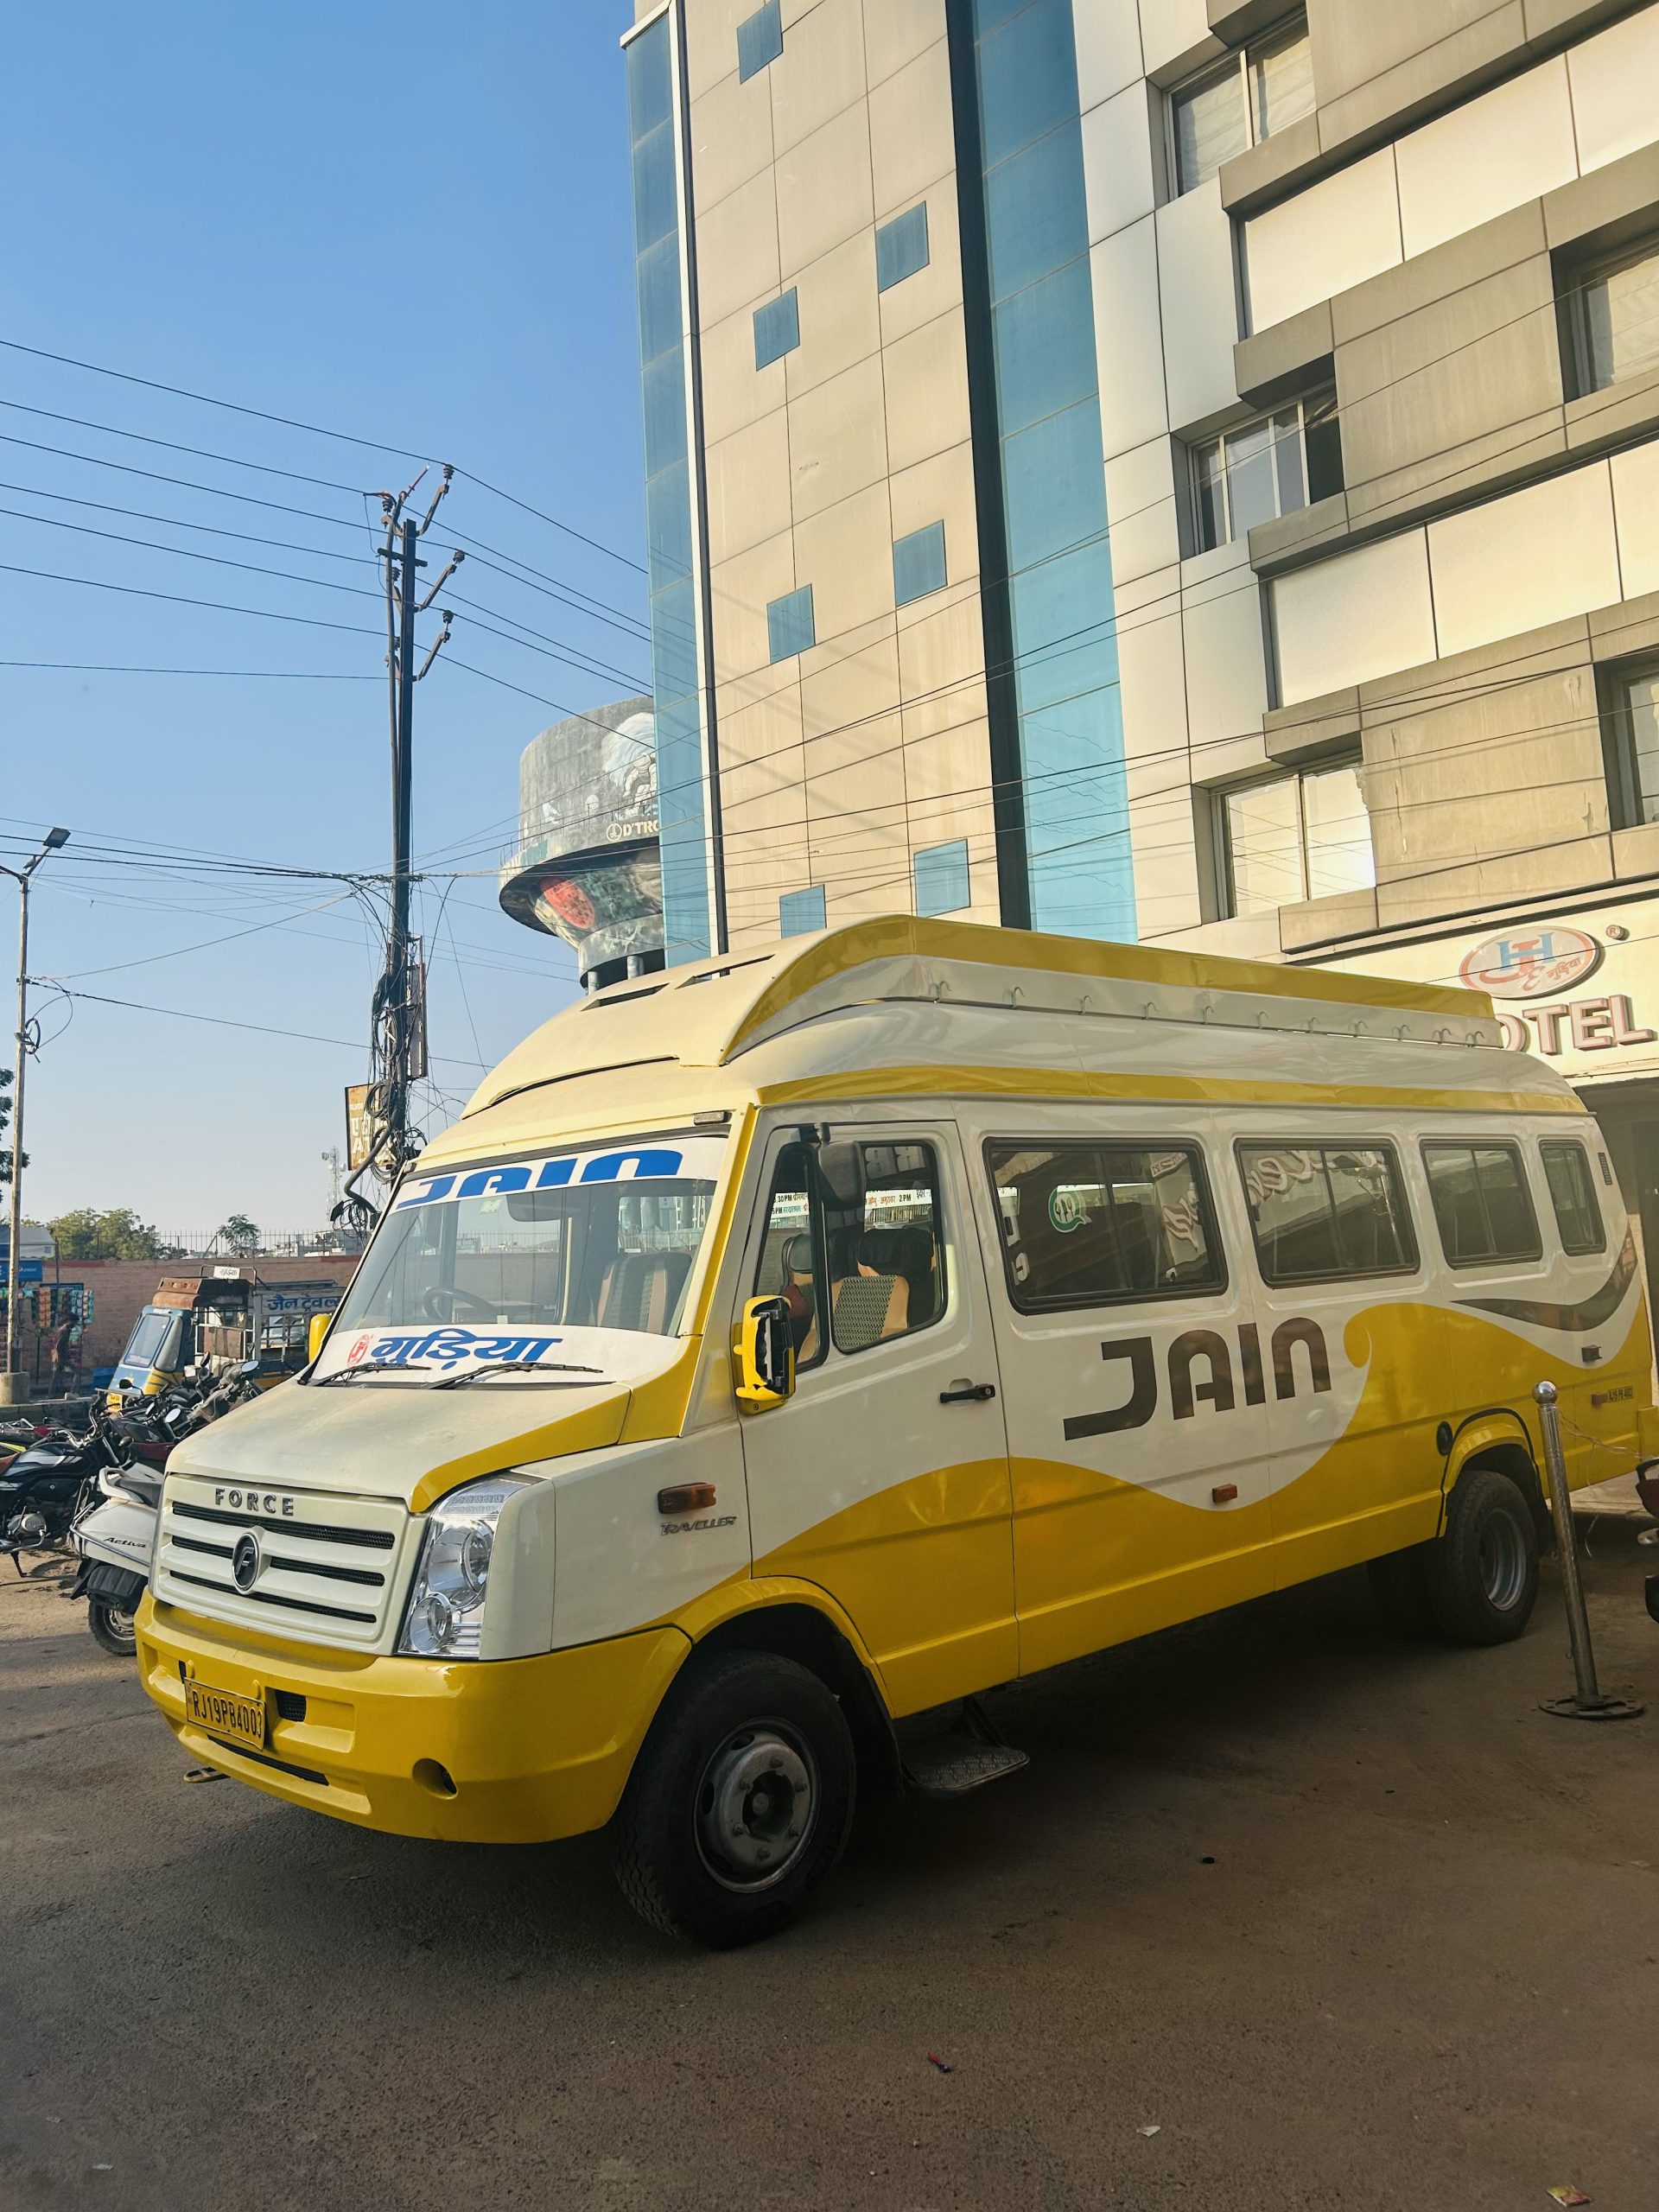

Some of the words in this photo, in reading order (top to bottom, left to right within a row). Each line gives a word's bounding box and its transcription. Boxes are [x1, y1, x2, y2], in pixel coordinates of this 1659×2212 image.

[397, 1149, 683, 1208] JAIN
[266, 1294, 299, 1311] जैन
[371, 1328, 563, 1370] गुड़िया
[1063, 1317, 1332, 1441] JAIN
[215, 1488, 294, 1516] FORCE
[104, 1537, 147, 1548] Activa
